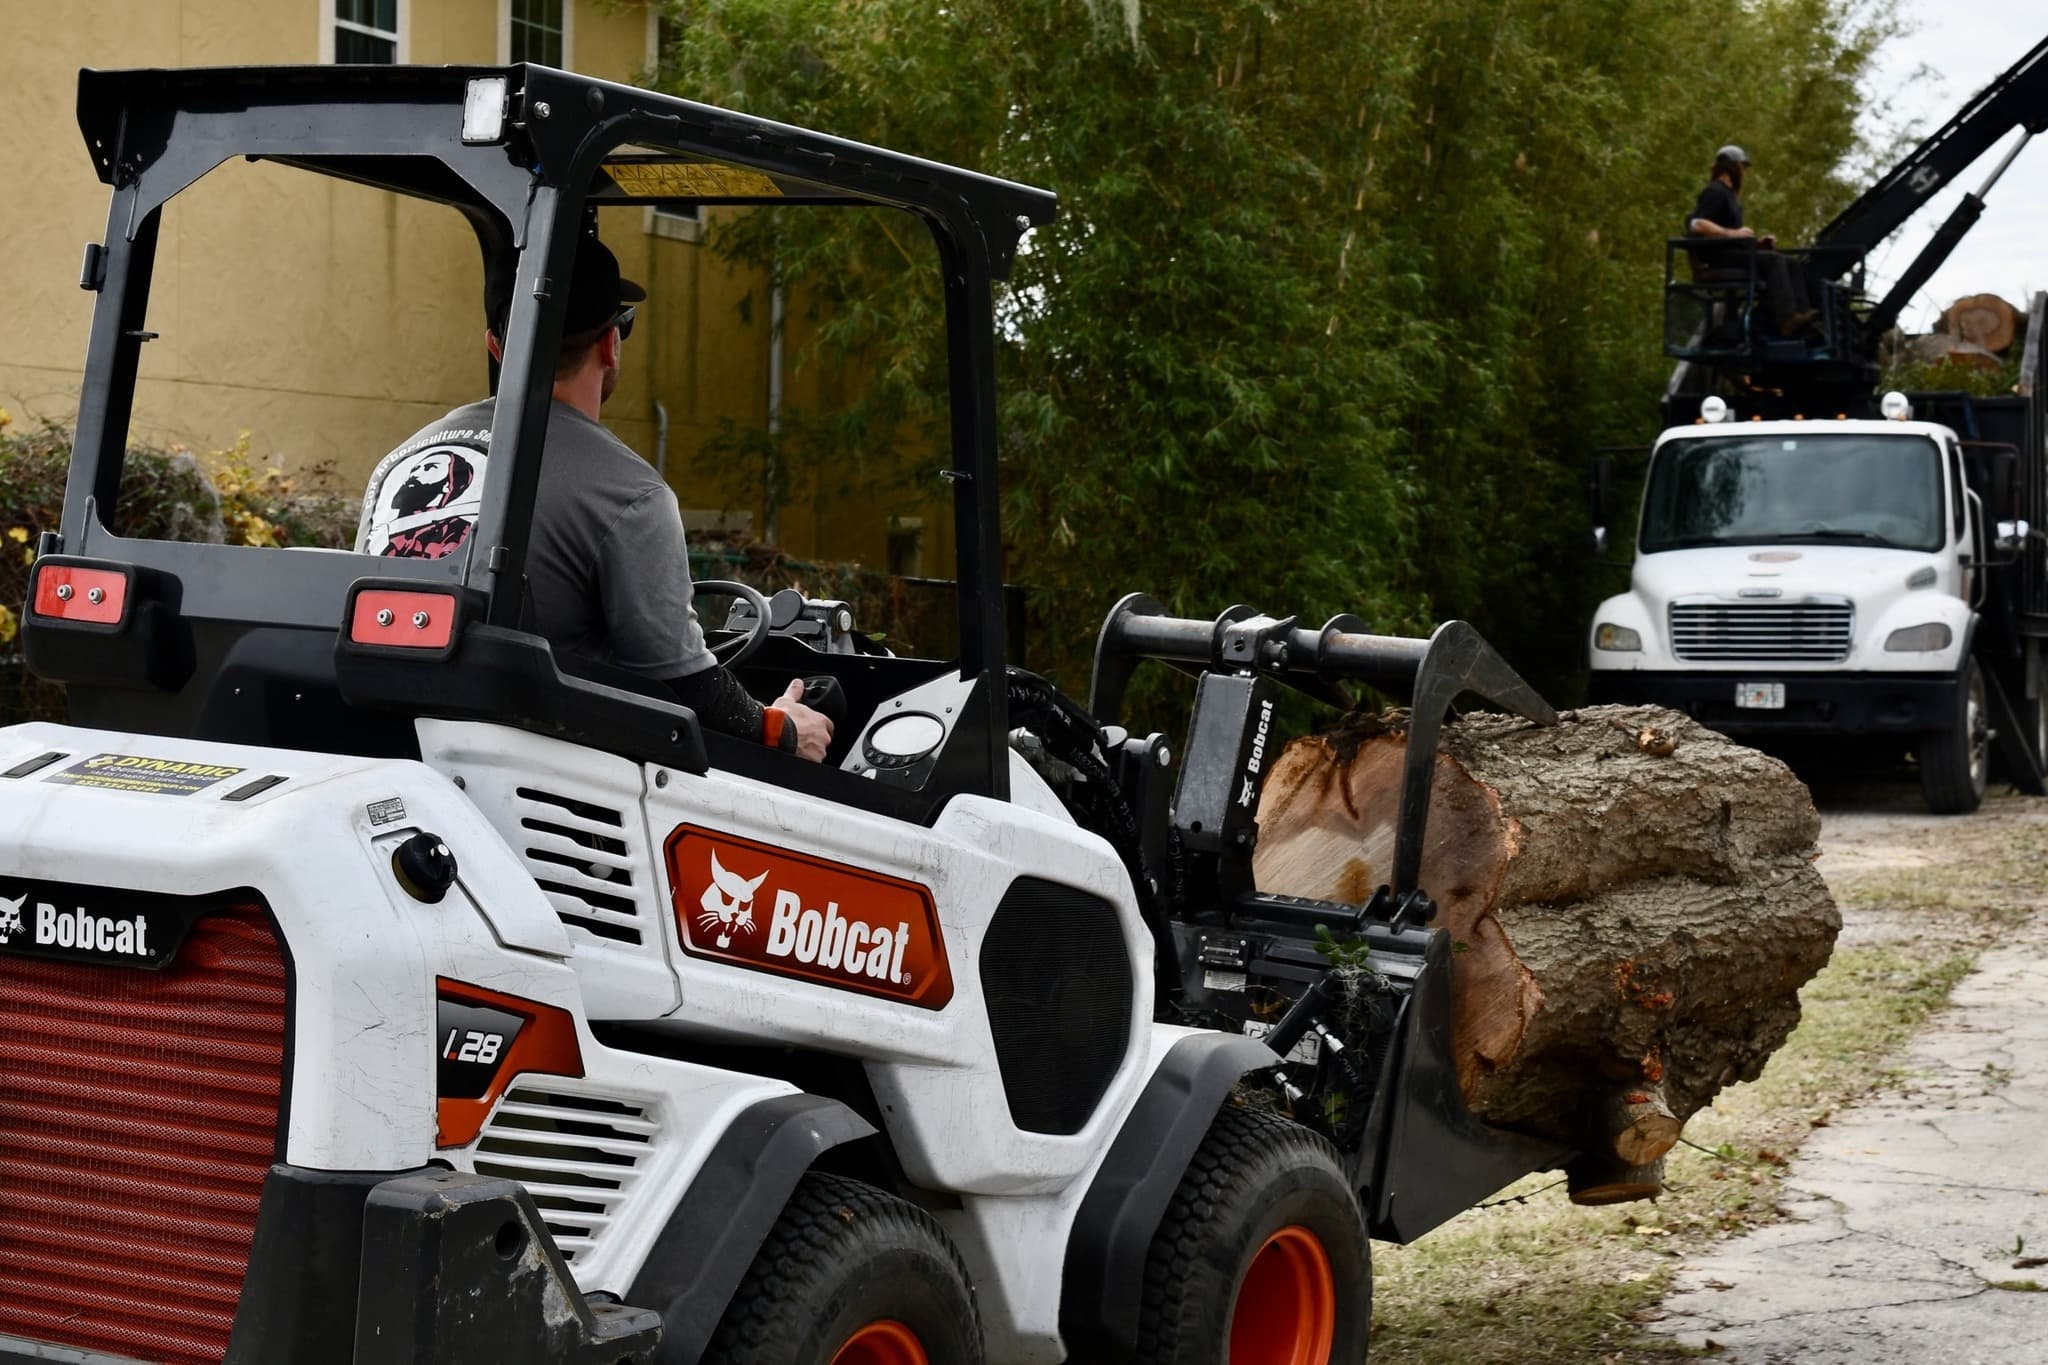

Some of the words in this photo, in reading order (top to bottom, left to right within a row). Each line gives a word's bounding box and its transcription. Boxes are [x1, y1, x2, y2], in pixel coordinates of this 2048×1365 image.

[114, 757, 240, 778] DYNAMIC
[1247, 699, 1274, 774] Bobcat
[35, 902, 147, 956] Bobcat
[766, 888, 910, 984] Bobcat
